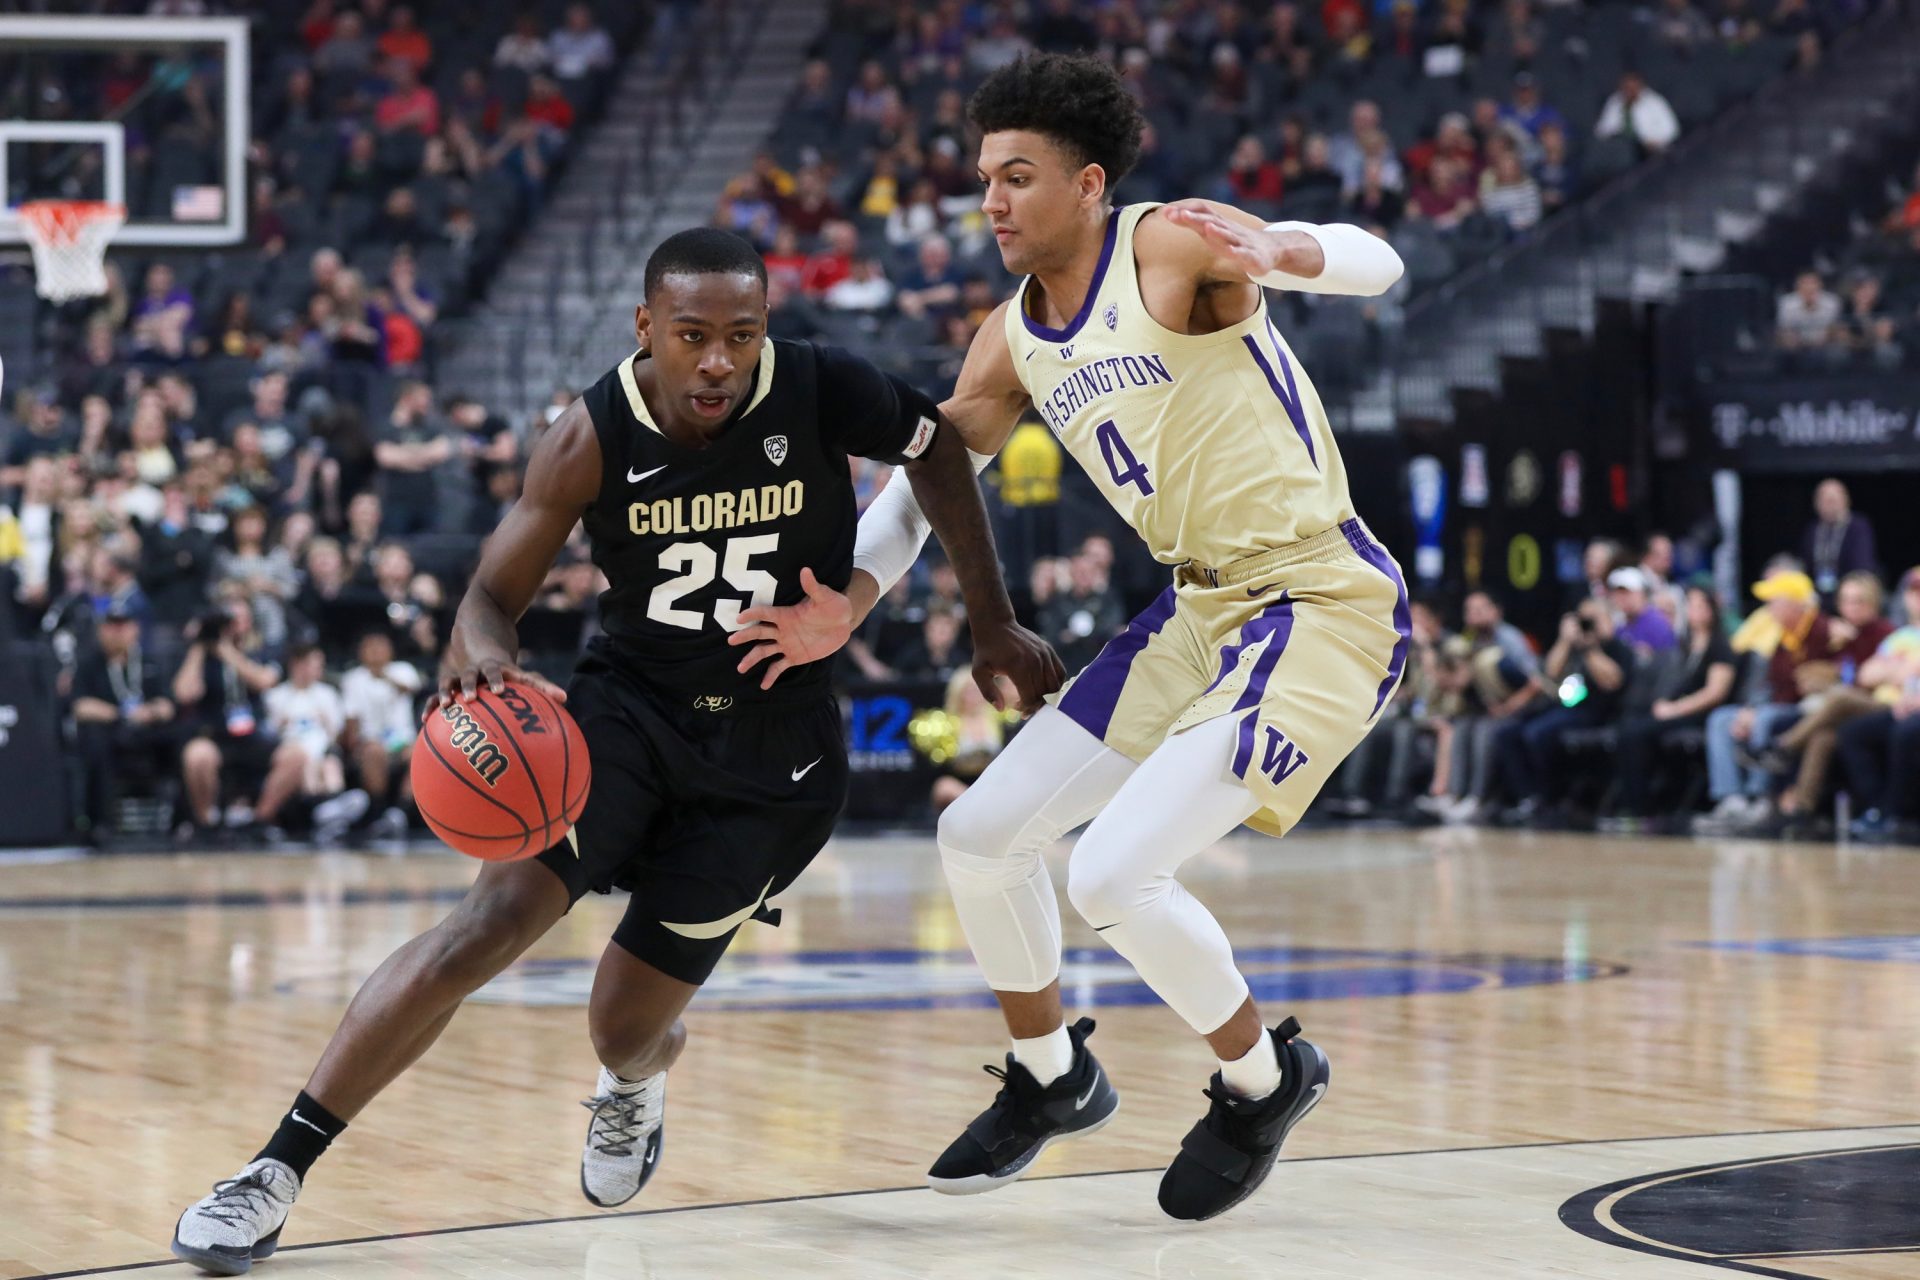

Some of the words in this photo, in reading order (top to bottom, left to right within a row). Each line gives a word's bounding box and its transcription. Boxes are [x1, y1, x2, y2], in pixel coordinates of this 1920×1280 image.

[1059, 344, 1075, 360] W
[771, 448, 783, 460] 12
[1096, 420, 1155, 496] 4
[628, 480, 804, 535] COLORADO
[647, 533, 780, 632] 25
[1203, 568, 1219, 588] W
[495, 687, 545, 735] NCA
[441, 703, 510, 789] Wilso
[1261, 724, 1310, 787] W
